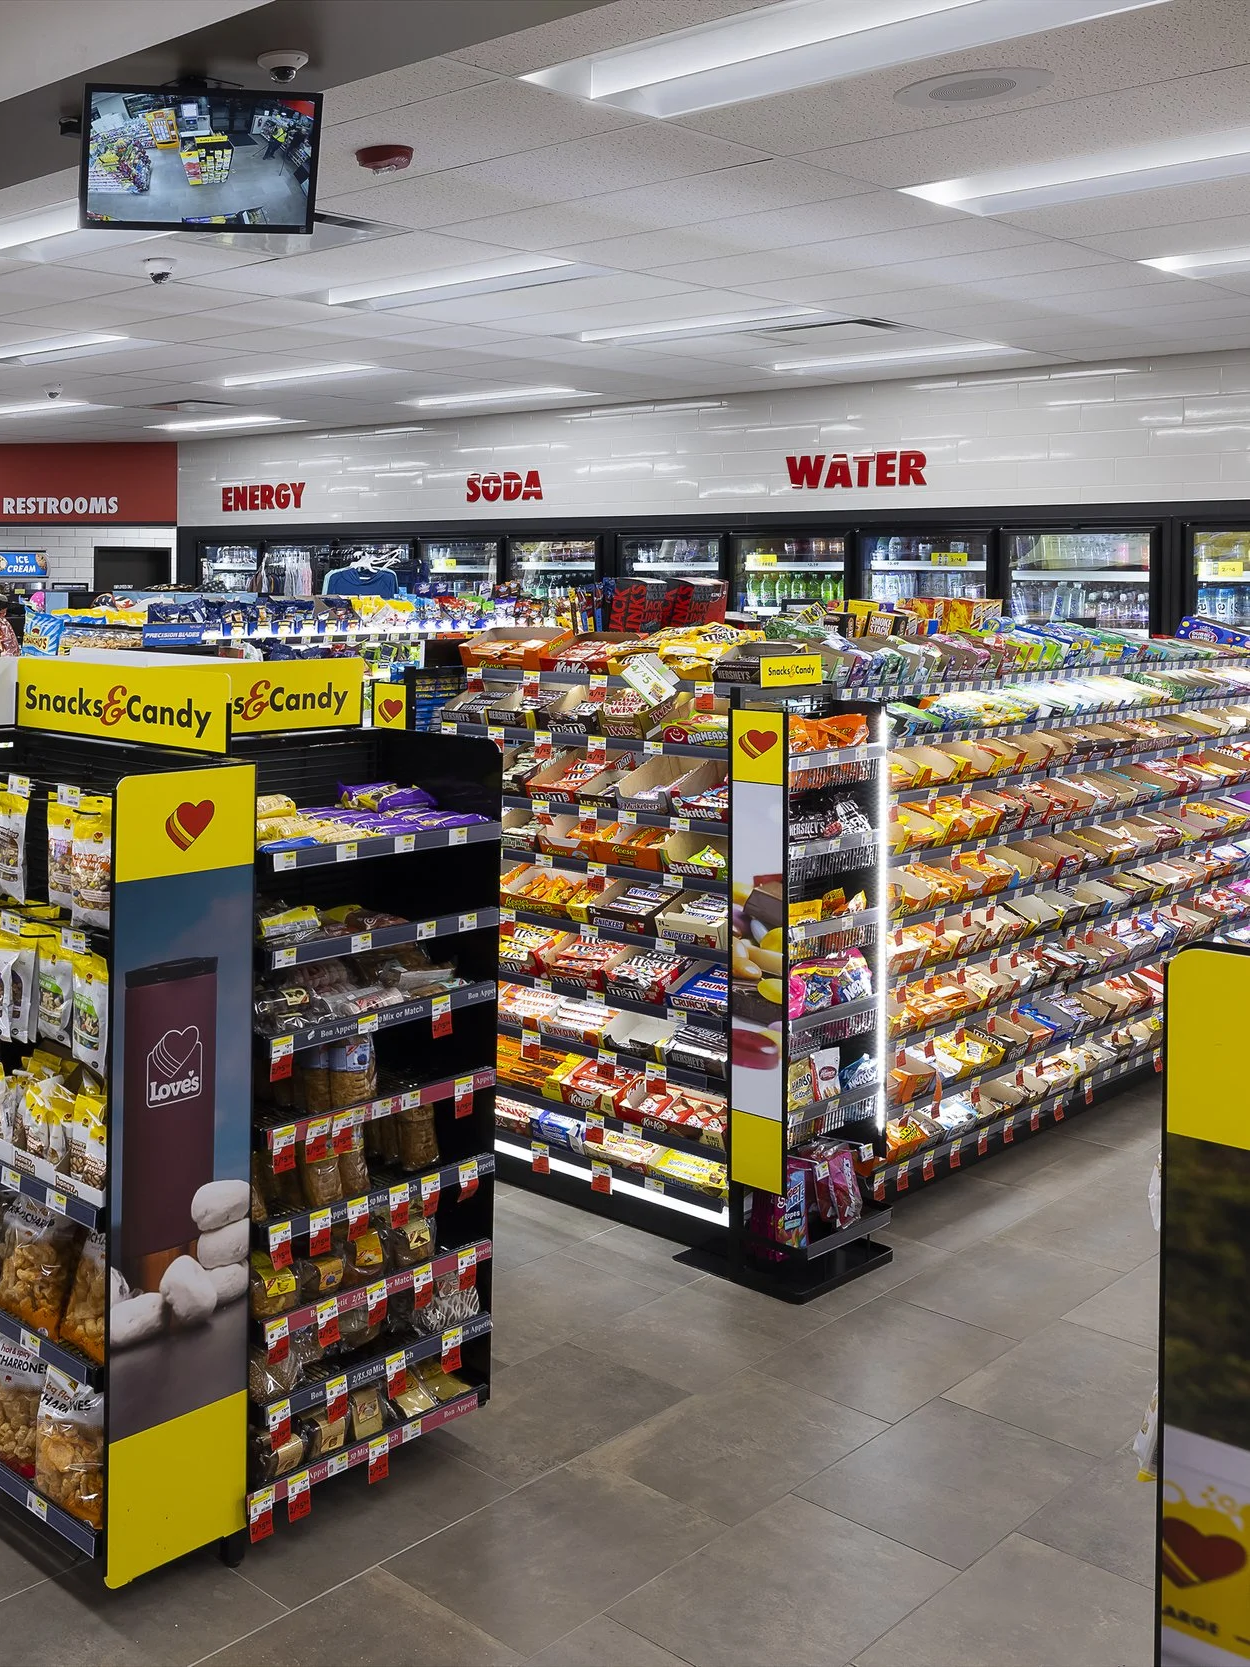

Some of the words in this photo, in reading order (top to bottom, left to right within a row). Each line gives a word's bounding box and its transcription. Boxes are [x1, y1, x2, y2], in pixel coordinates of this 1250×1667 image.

[786, 450, 927, 489] WATER
[466, 470, 543, 503] SODA
[222, 482, 305, 512] ENERGY
[2, 496, 118, 515] RESTROOMS
[15, 555, 29, 565] ICE
[7, 564, 37, 574] CREAM
[610, 587, 630, 632] JACK
[871, 615, 892, 627] SMOKE
[145, 631, 178, 639] PRECISION
[179, 631, 201, 639] BLADES
[870, 625, 890, 636] STACK
[687, 731, 729, 744] AIRHEADS
[679, 807, 722, 820] Skittles
[669, 864, 713, 876] Skittles
[629, 887, 659, 898] SNICKERS
[594, 917, 624, 930] SNICKERS
[663, 930, 695, 942] SNICKERS
[694, 980, 728, 992] CRUNC
[468, 990, 478, 999] Bon
[672, 998, 707, 1011] CRUNCH
[382, 1012, 394, 1023] Mix
[396, 1011, 402, 1019] or
[404, 1005, 424, 1017] Match
[320, 1027, 334, 1038] Bon
[671, 1052, 704, 1068] HERSHEY'S
[791, 1073, 813, 1090] HARIBO
[394, 1273, 414, 1286] Match
[373, 1363, 385, 1375] Mix
[310, 1389, 323, 1401] Bon
[443, 1408, 456, 1419] Bon
[457, 1399, 478, 1413] Appetit
